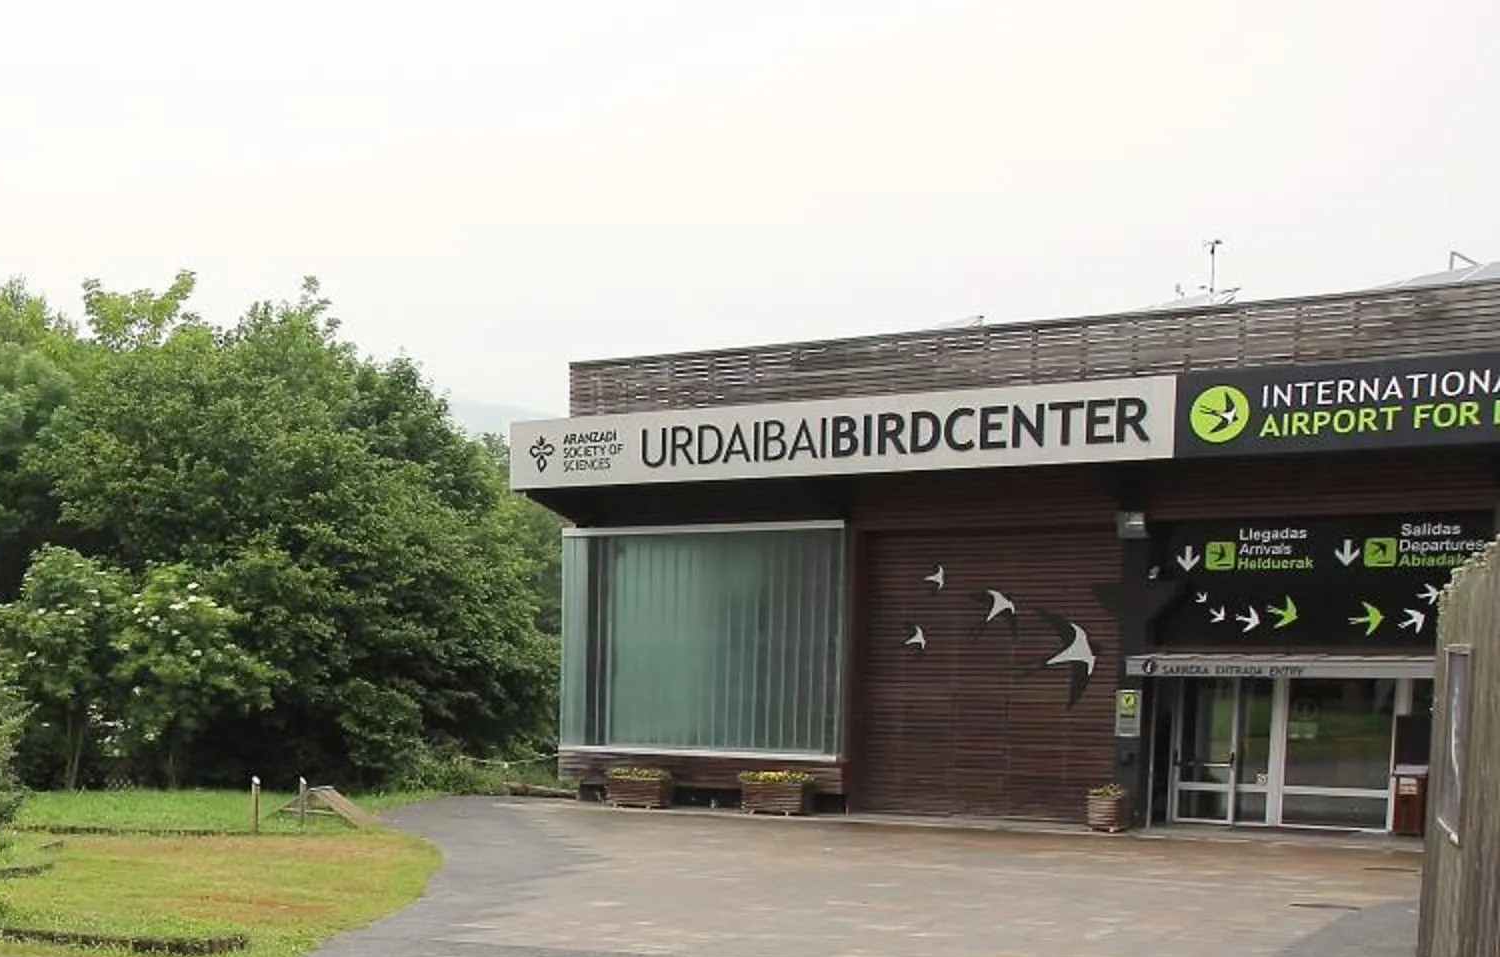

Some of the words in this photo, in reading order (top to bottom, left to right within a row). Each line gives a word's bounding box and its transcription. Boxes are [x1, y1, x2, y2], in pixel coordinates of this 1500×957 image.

[1259, 406, 1403, 438] AIRPORT
[1413, 401, 1481, 429] FOR
[563, 430, 617, 445] ARANZADI
[641, 397, 1150, 468] URDAIBAIBIRDCENTER
[563, 445, 607, 459] SOCIETY
[608, 443, 624, 455] OF
[563, 458, 611, 472] SCIENCES
[1239, 527, 1308, 543] Llegadas
[1401, 522, 1461, 537] Salidas
[1239, 543, 1293, 556] Arrivals
[1399, 539, 1485, 556] Departures
